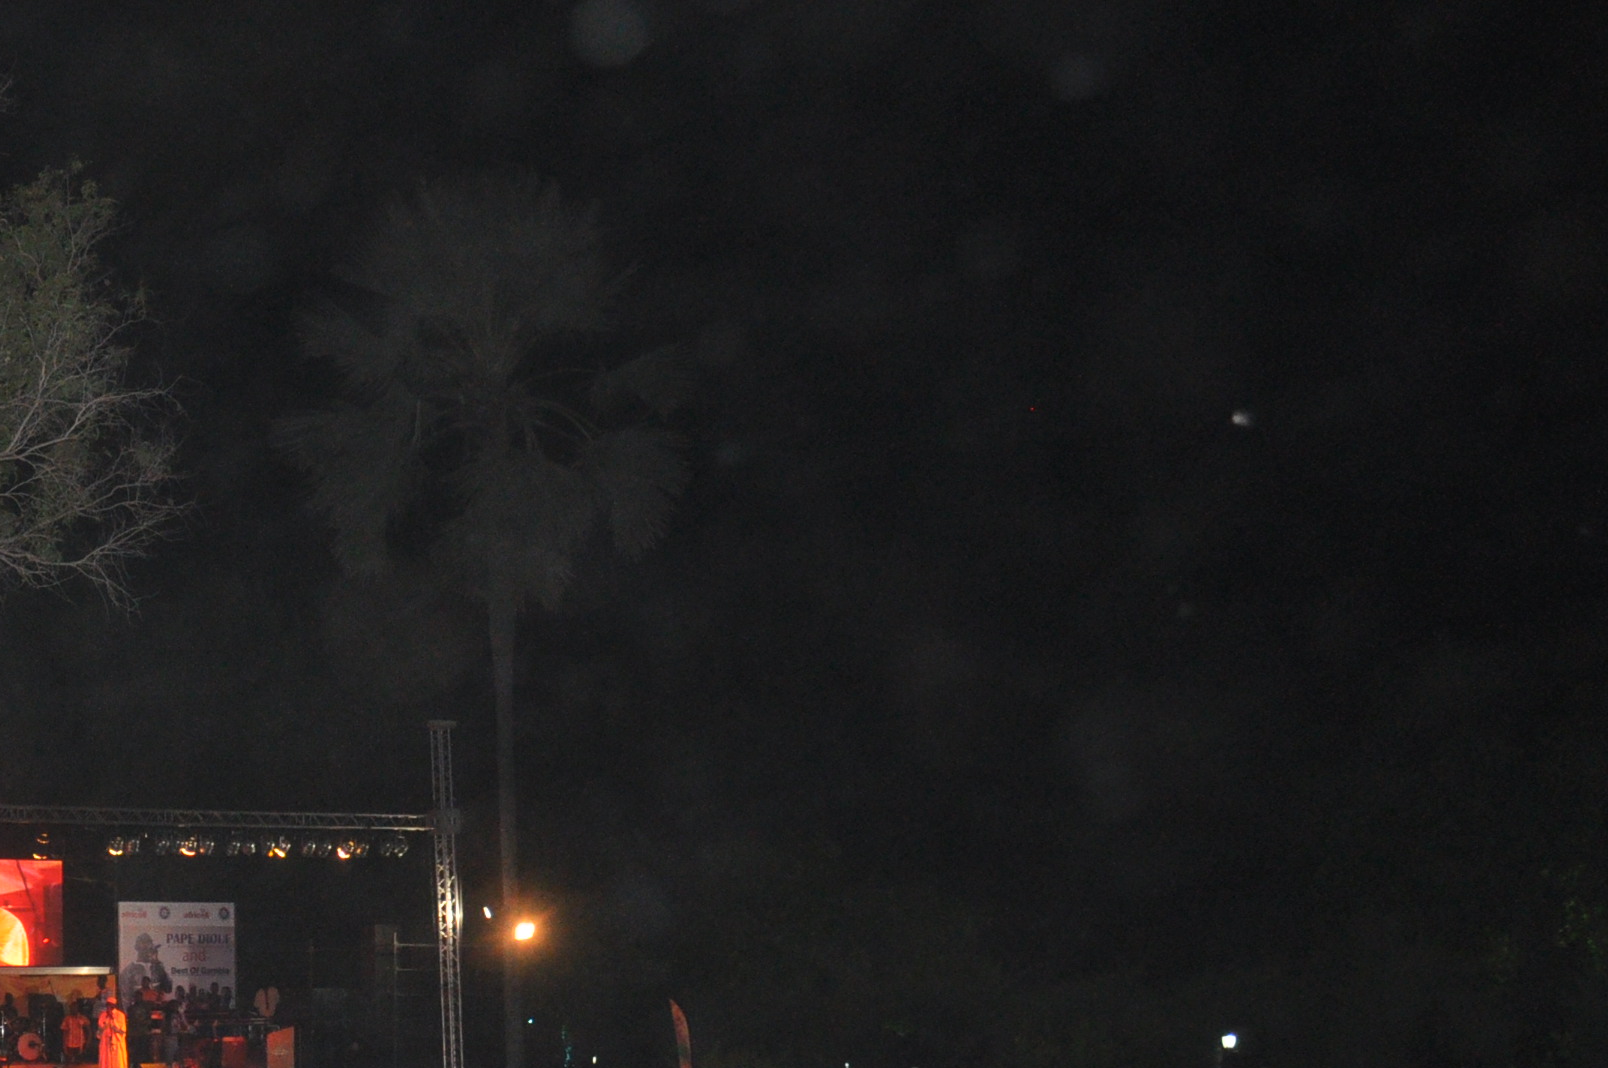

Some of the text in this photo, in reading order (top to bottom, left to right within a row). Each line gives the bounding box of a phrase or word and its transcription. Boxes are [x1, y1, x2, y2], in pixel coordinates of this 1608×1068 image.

[166, 932, 193, 945] PAPE
[182, 948, 207, 962] and
[171, 966, 189, 975] Best
